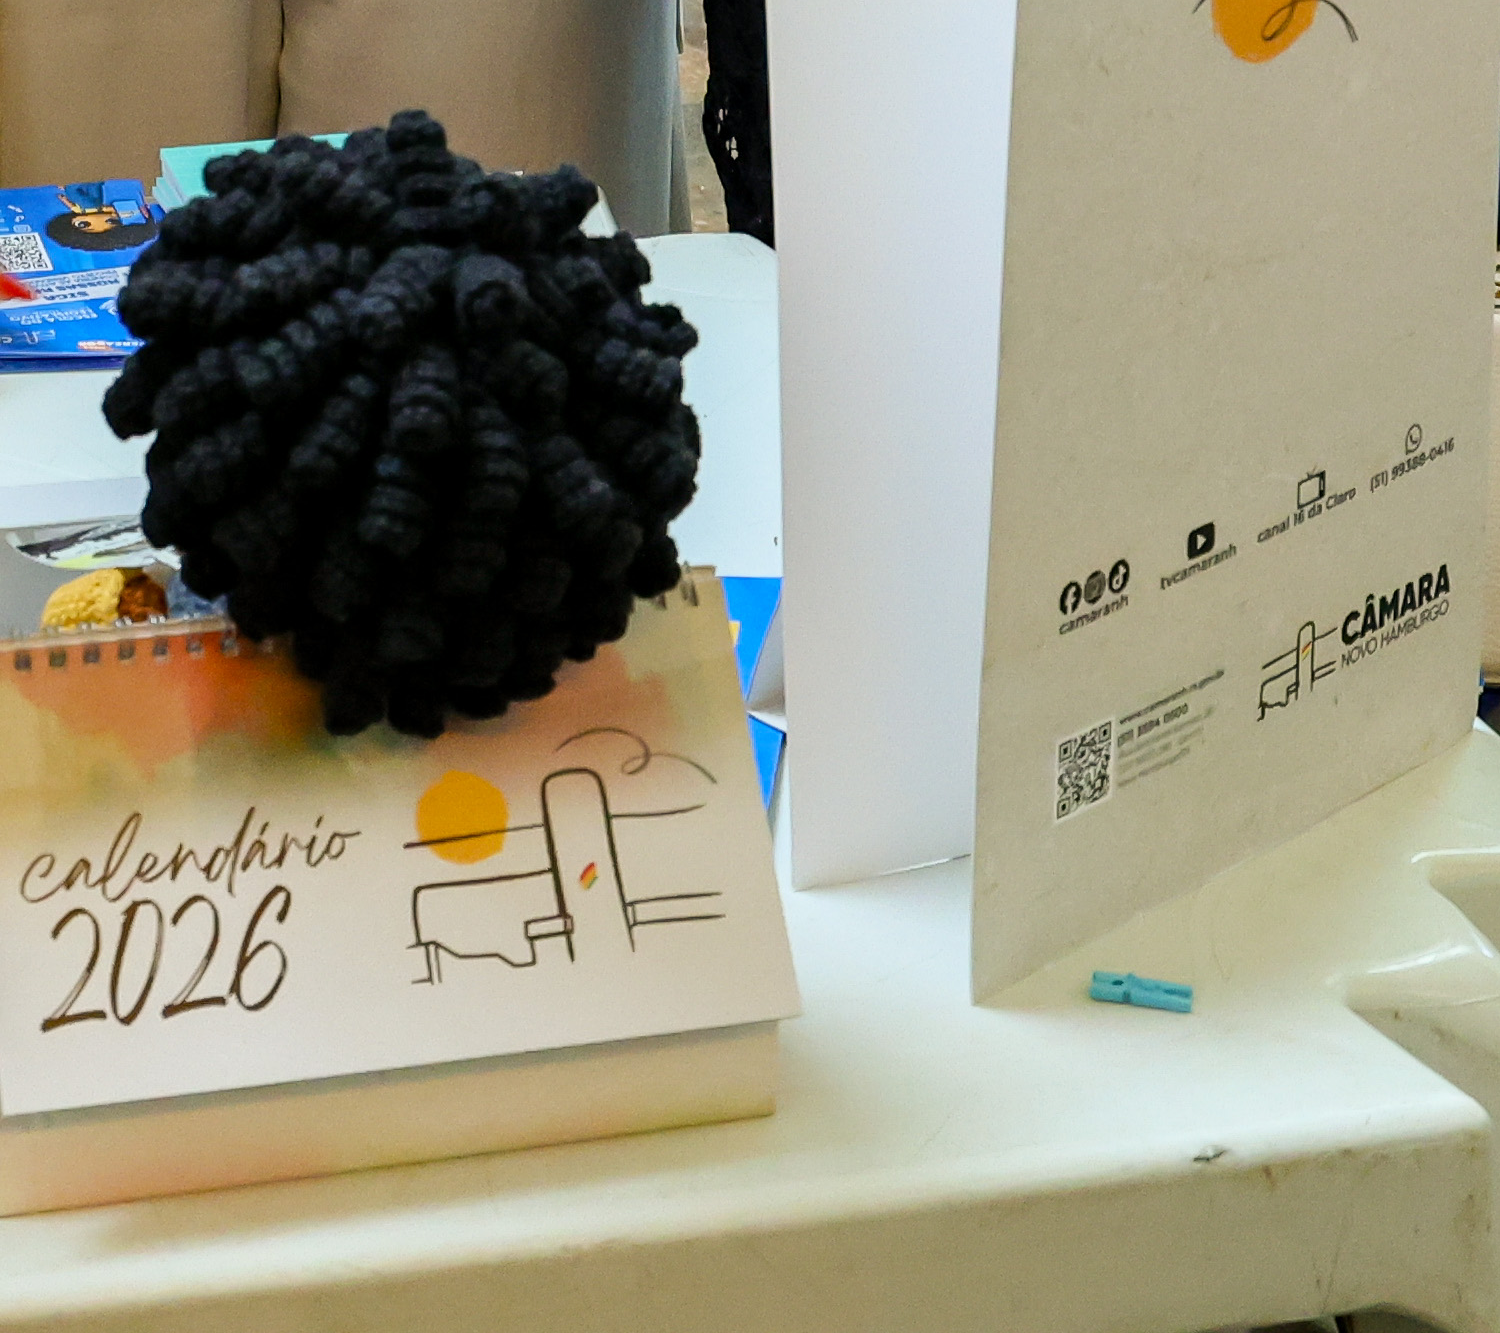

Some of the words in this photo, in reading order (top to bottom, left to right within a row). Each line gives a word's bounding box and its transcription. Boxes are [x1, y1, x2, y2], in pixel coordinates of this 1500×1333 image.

[1369, 469, 1389, 494] (51)
[1256, 515, 1290, 544] canal
[1307, 501, 1323, 520] da
[1325, 487, 1357, 511] Claro
[1159, 543, 1238, 591] tvcamaranh
[1058, 594, 1130, 636] camaranh
[1341, 564, 1451, 646] CÂMARA
[1341, 636, 1378, 669] NOVO
[1380, 598, 1450, 649] HAMBURGO
[19, 806, 362, 903] calendário
[40, 885, 292, 1033] 2026
